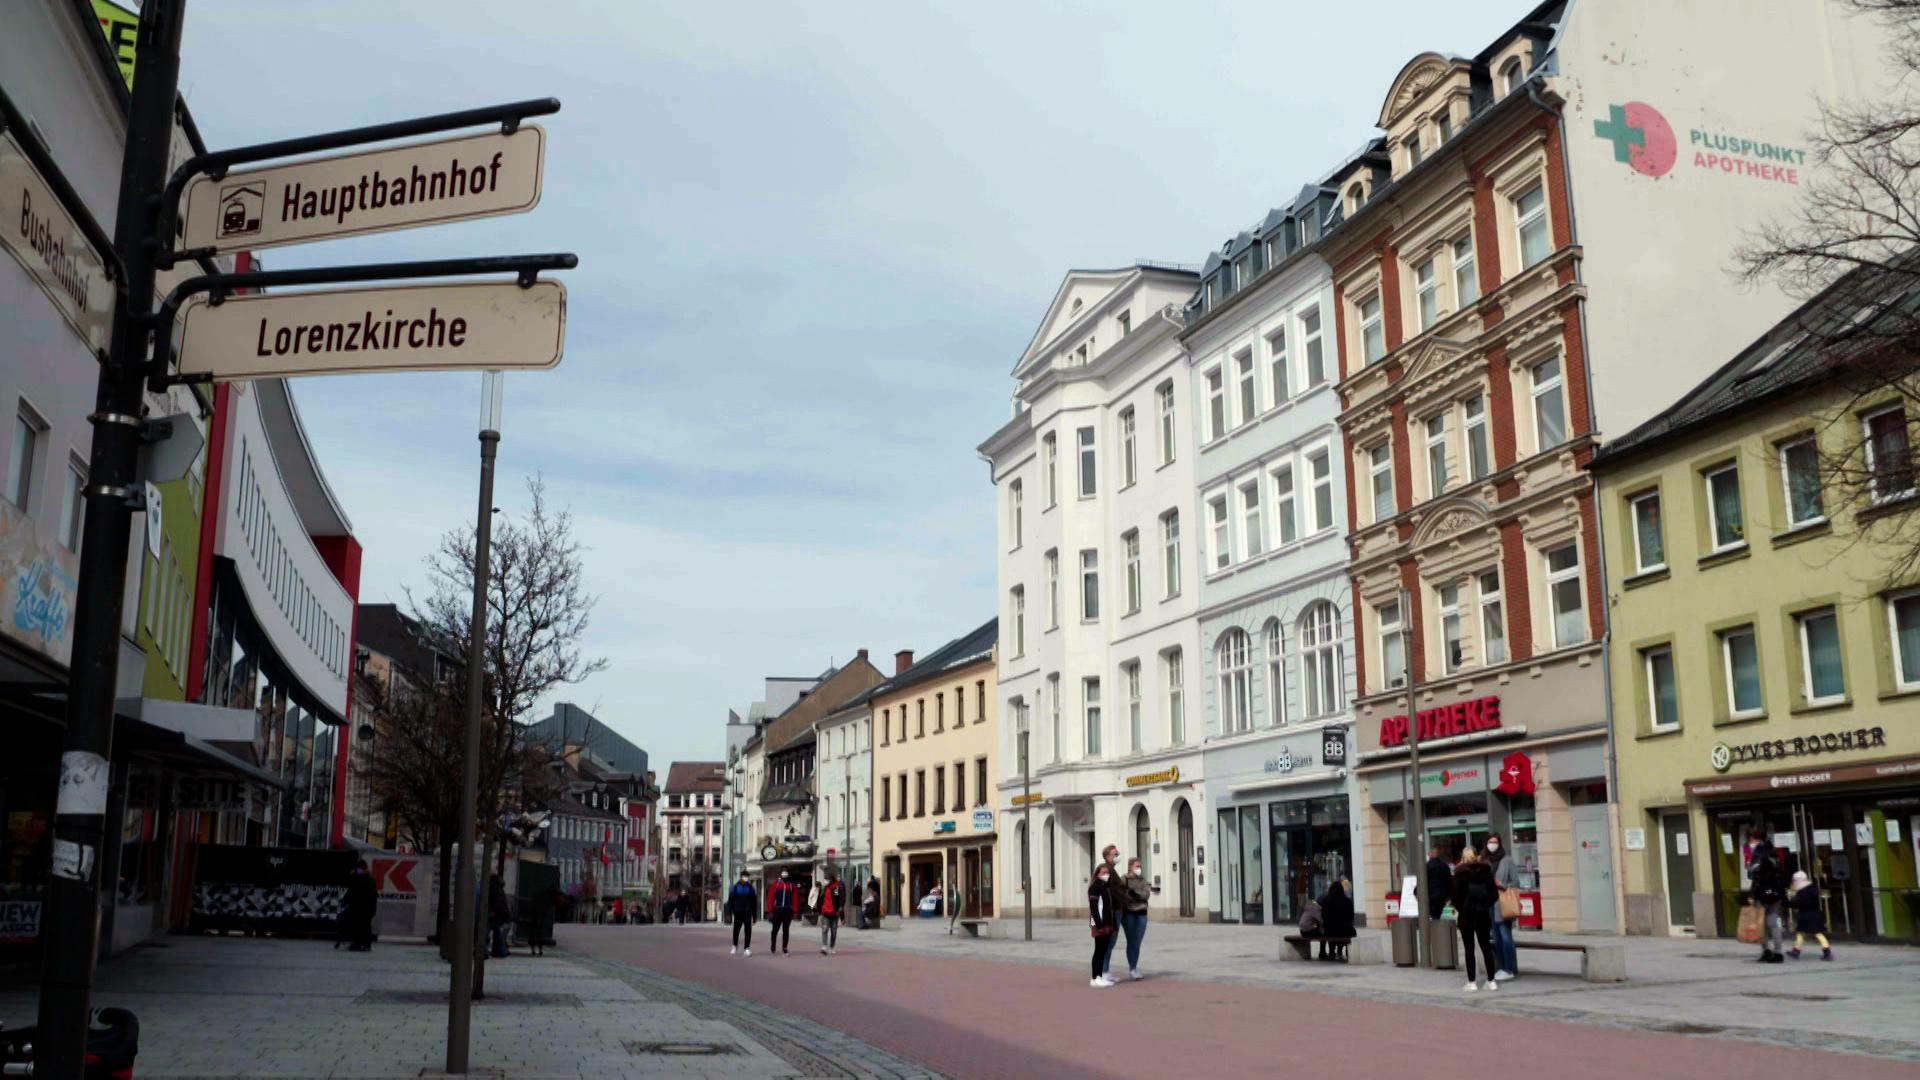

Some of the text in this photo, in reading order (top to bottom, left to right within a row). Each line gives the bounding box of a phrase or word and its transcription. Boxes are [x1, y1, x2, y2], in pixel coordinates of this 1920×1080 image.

[1690, 128, 1806, 165] PLUSPUNKT
[1694, 151, 1799, 185] APOTHEKE
[282, 152, 502, 224] Hauptbahnhof
[20, 187, 90, 313] Busbahnhof
[257, 308, 467, 357] Lorenzkirche
[1734, 726, 1886, 764] YVES ROCHER
[1799, 773, 1831, 784] ROCHER
